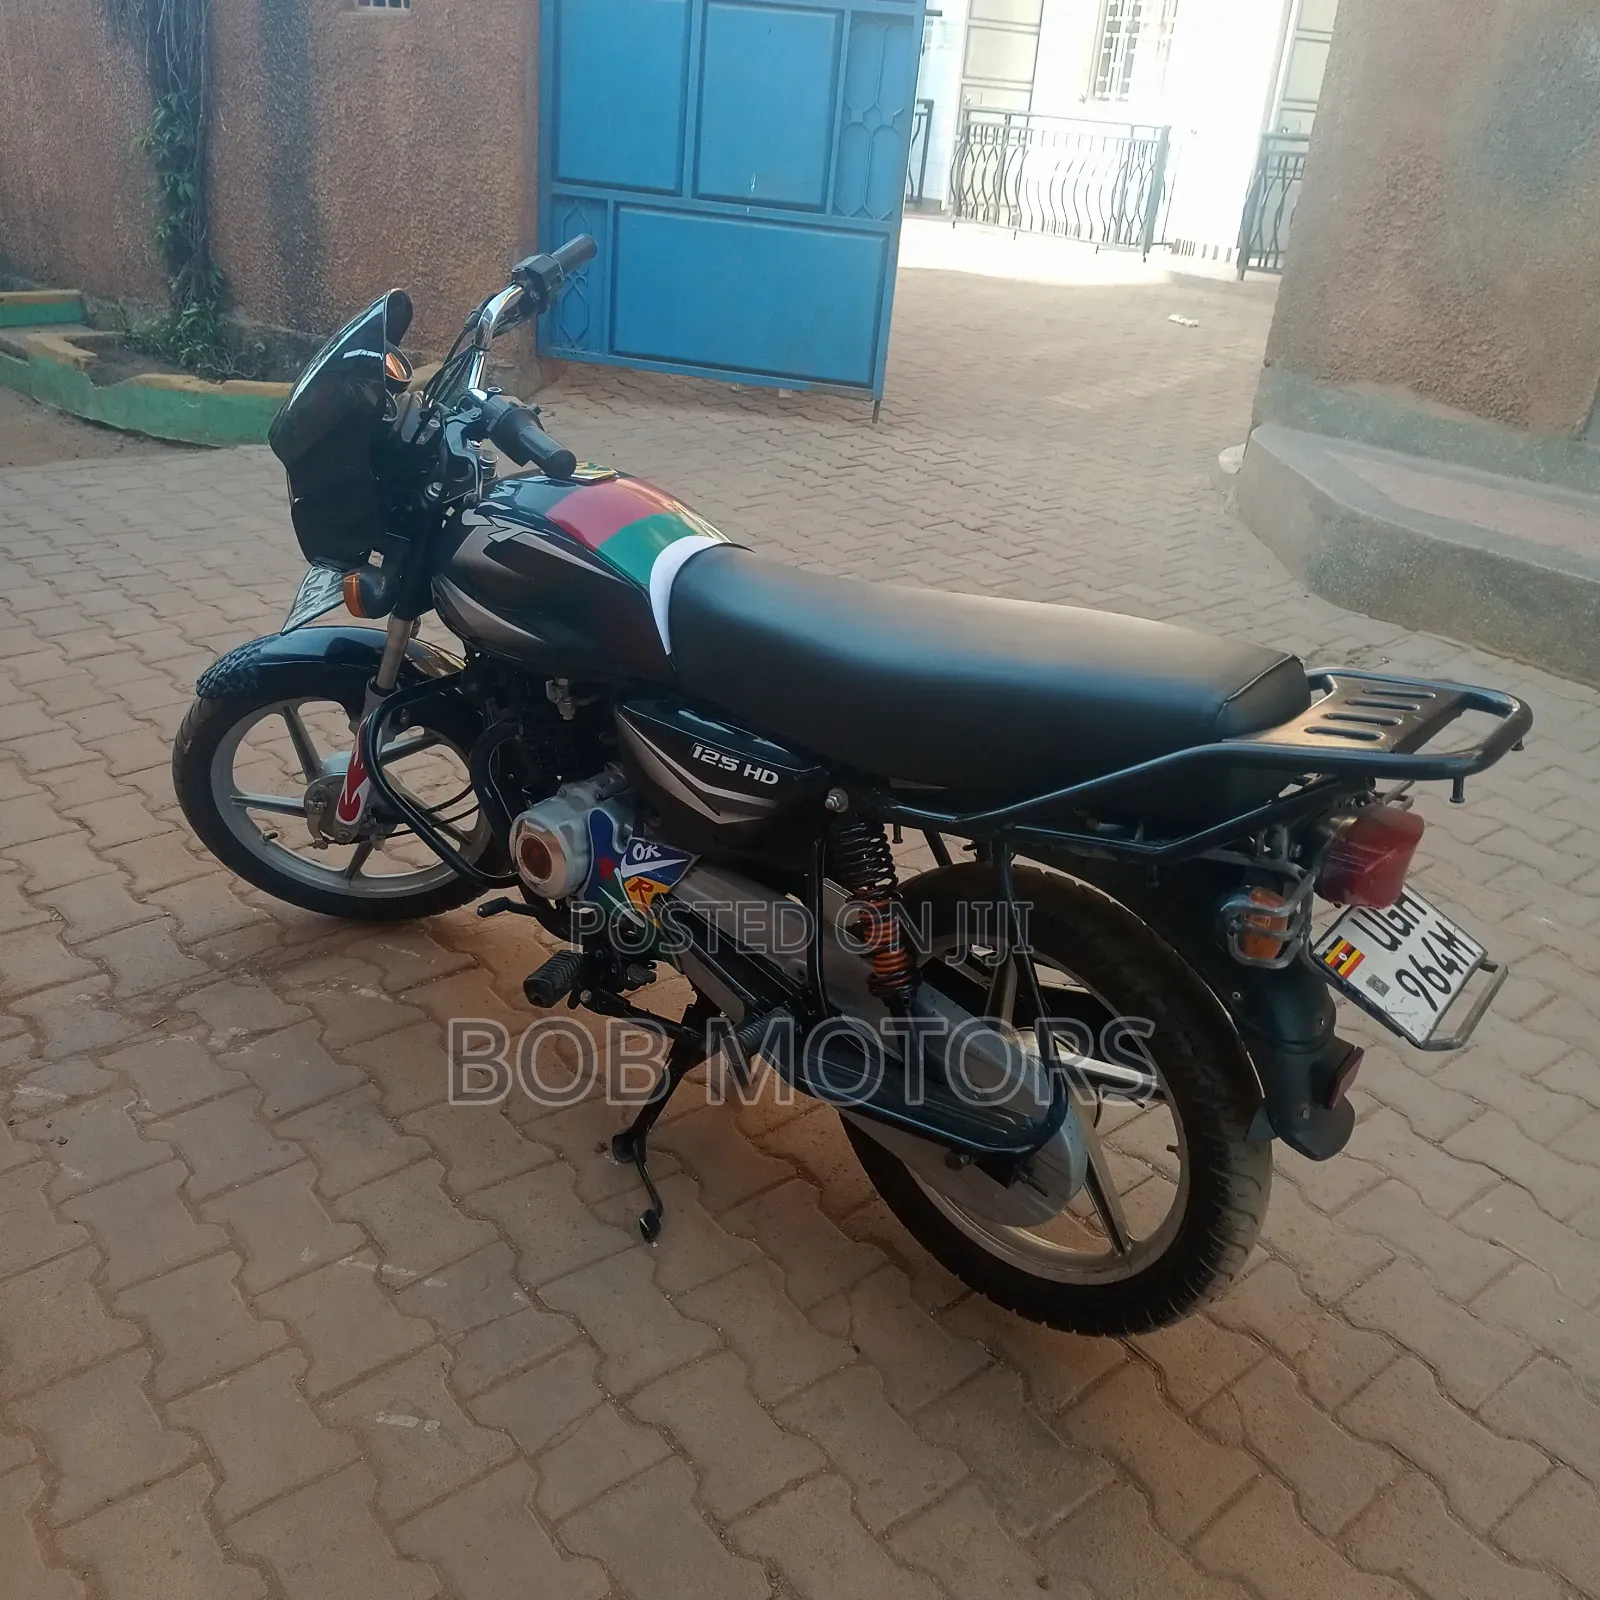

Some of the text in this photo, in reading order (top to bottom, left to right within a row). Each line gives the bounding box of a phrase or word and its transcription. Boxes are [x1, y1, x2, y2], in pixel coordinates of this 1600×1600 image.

[743, 763, 779, 785] HD
[632, 843, 662, 861] OK
[1395, 920, 1477, 1012] 964M
